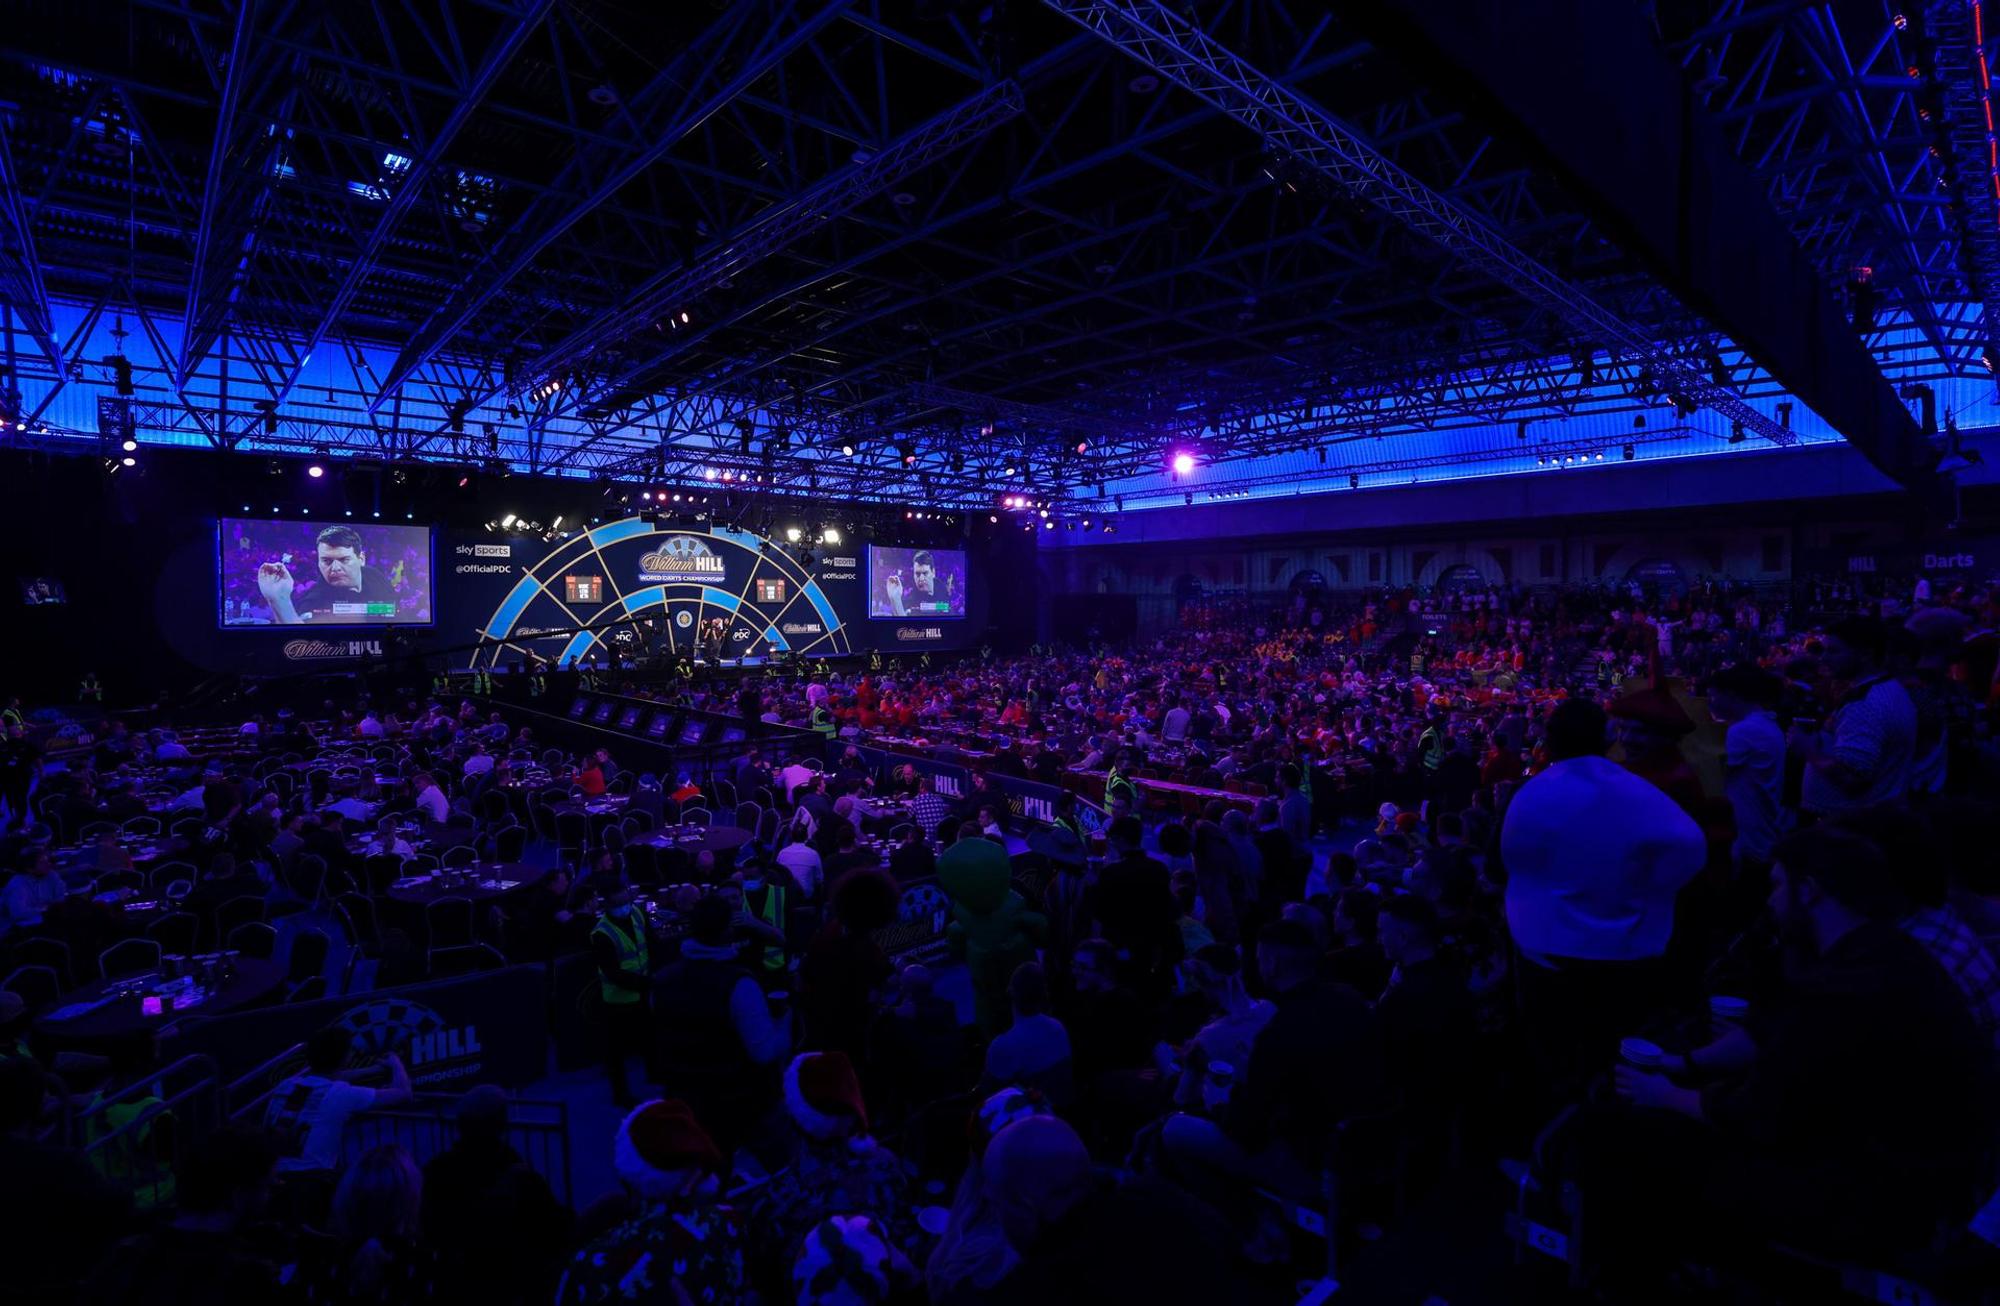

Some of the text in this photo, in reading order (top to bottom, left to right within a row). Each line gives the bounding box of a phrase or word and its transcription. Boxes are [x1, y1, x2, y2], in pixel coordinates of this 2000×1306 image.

[456, 544, 510, 556] sky sports
[456, 564, 511, 574] @OfficialPDC
[641, 554, 724, 572] William HILL
[822, 557, 833, 565] sky
[1923, 553, 1975, 569] Darts
[733, 630, 749, 640] PDC
[926, 628, 942, 638] HILL
[284, 640, 383, 659] William HILL
[934, 774, 959, 796] HILL
[1024, 796, 1054, 823] HILL
[411, 1024, 481, 1066] HILL
